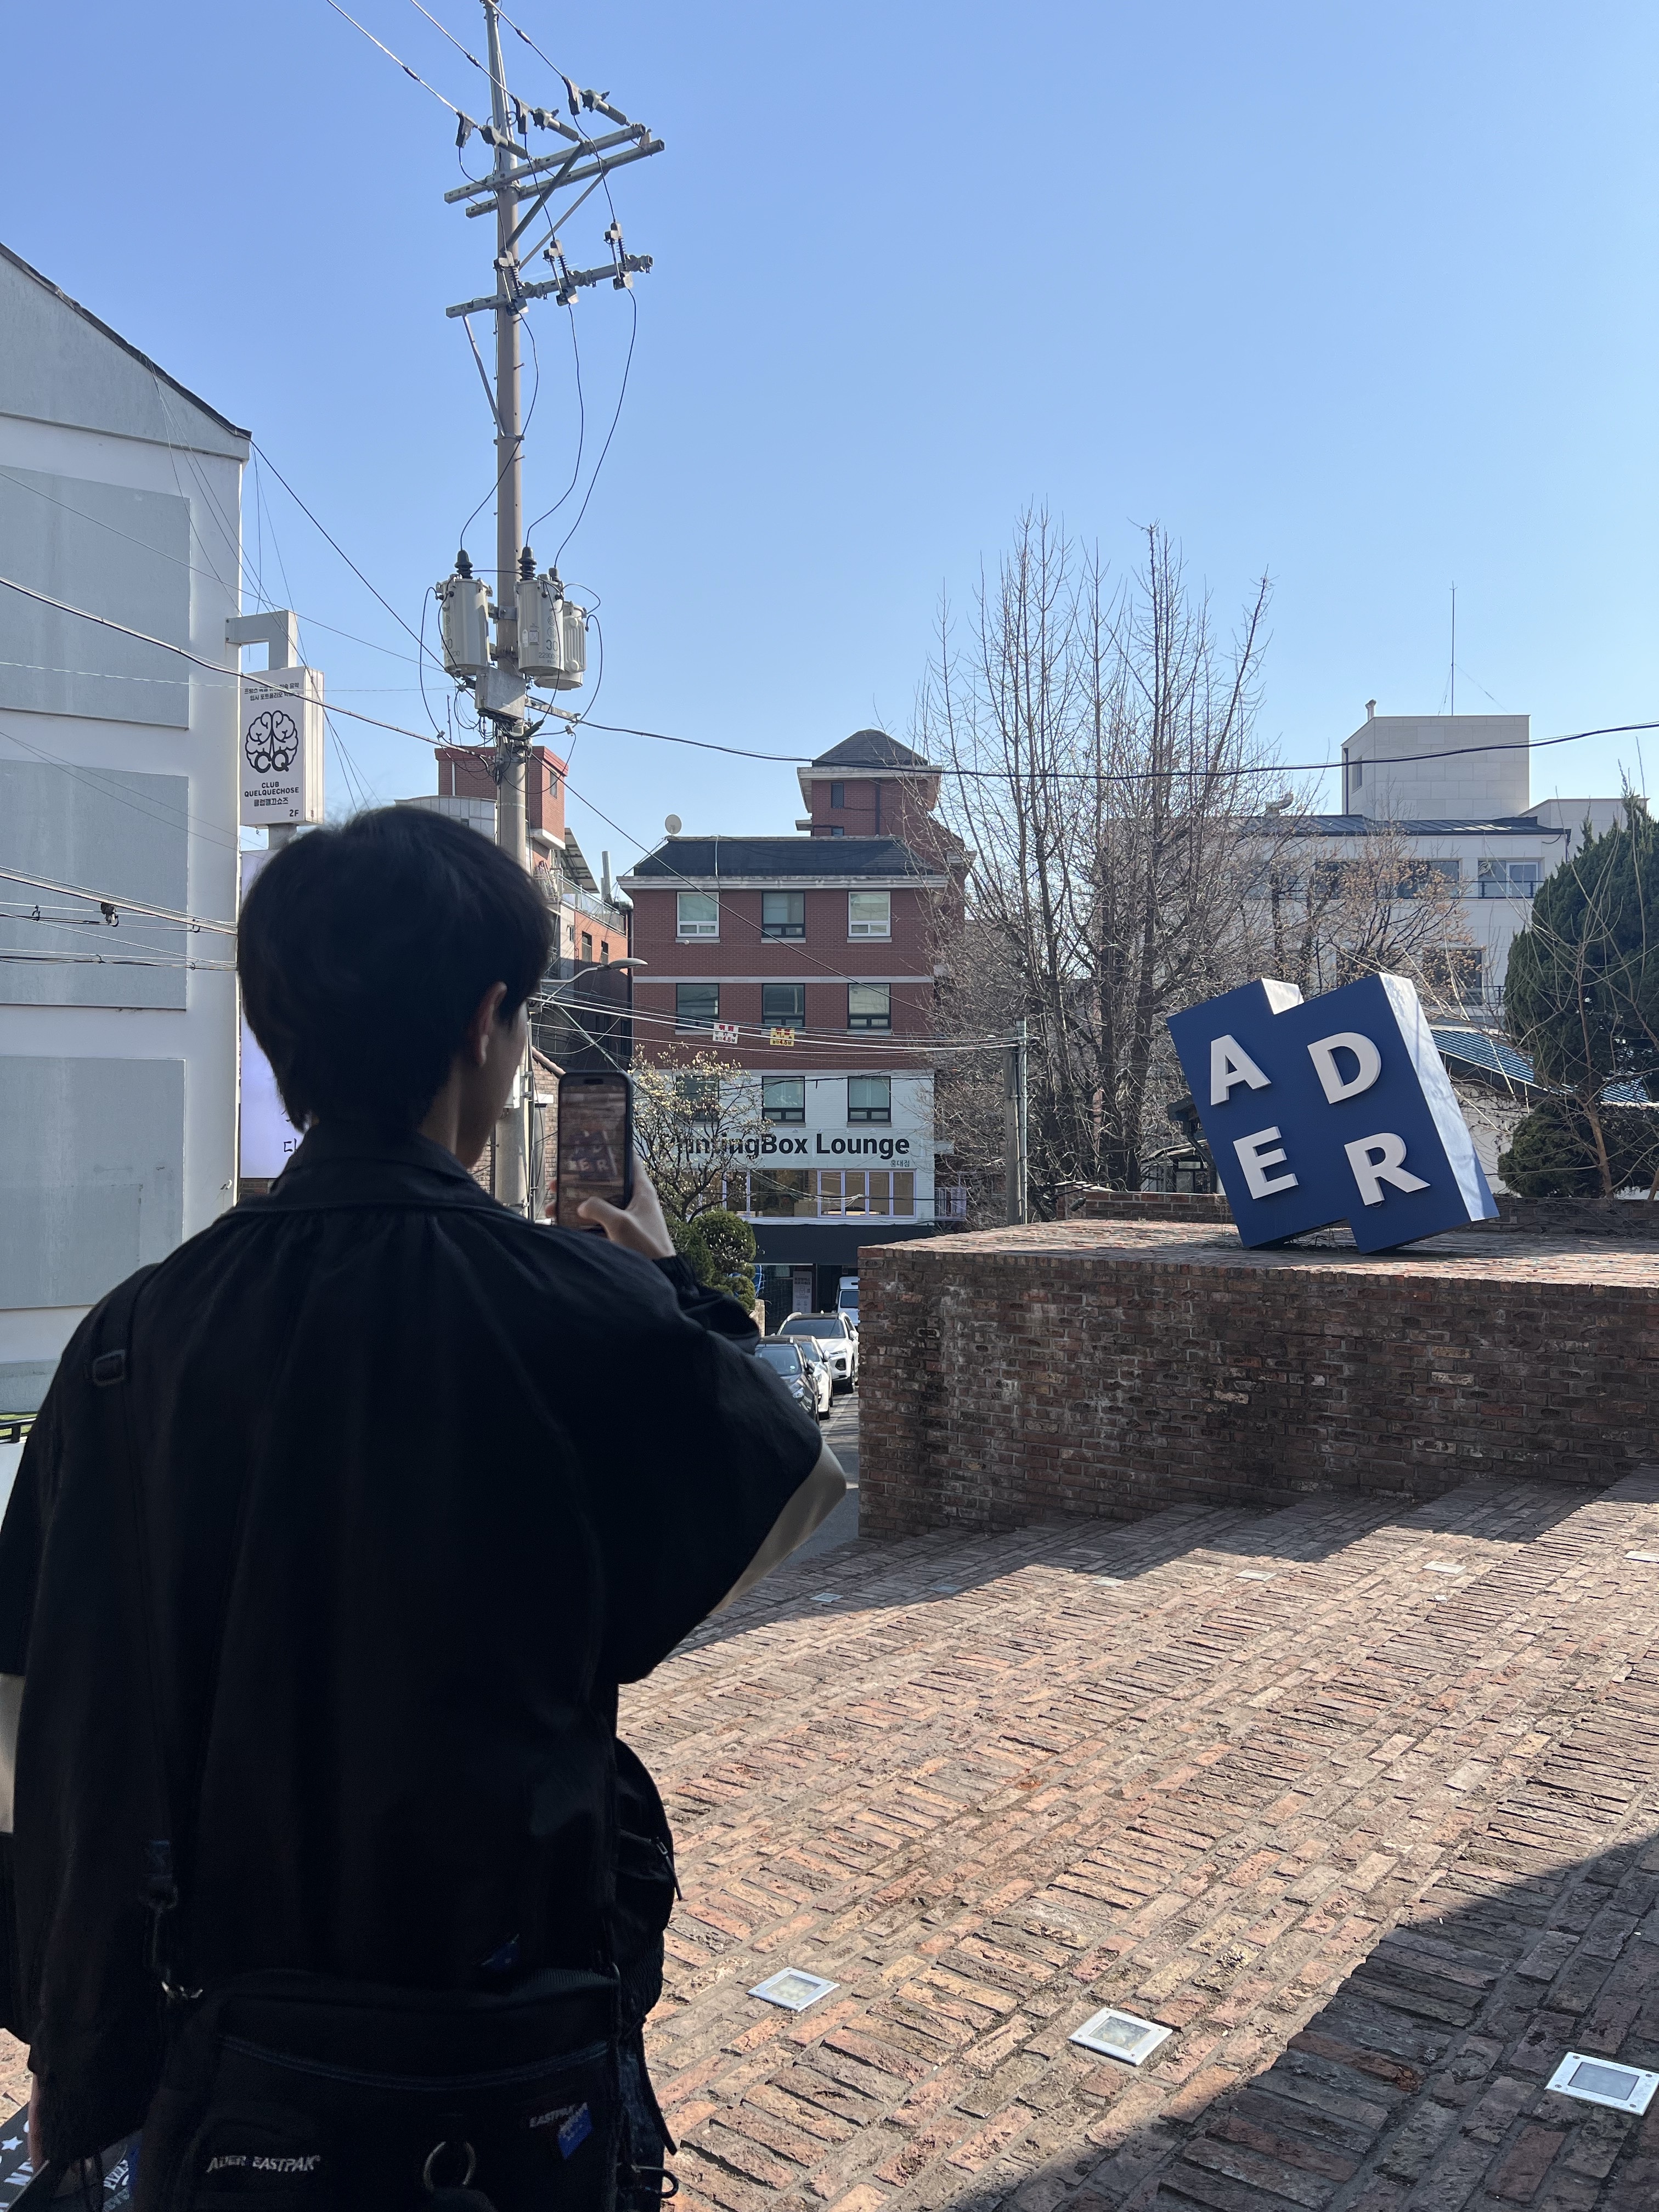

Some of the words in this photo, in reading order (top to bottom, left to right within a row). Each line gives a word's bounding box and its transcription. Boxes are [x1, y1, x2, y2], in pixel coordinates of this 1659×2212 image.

[546, 639, 558, 652] 30
[260, 692, 283, 700] 포트폴리오
[244, 787, 300, 797] QUELQUECHOSE
[816, 1133, 910, 1160] Lounge
[889, 1159, 910, 1167] 홍대점
